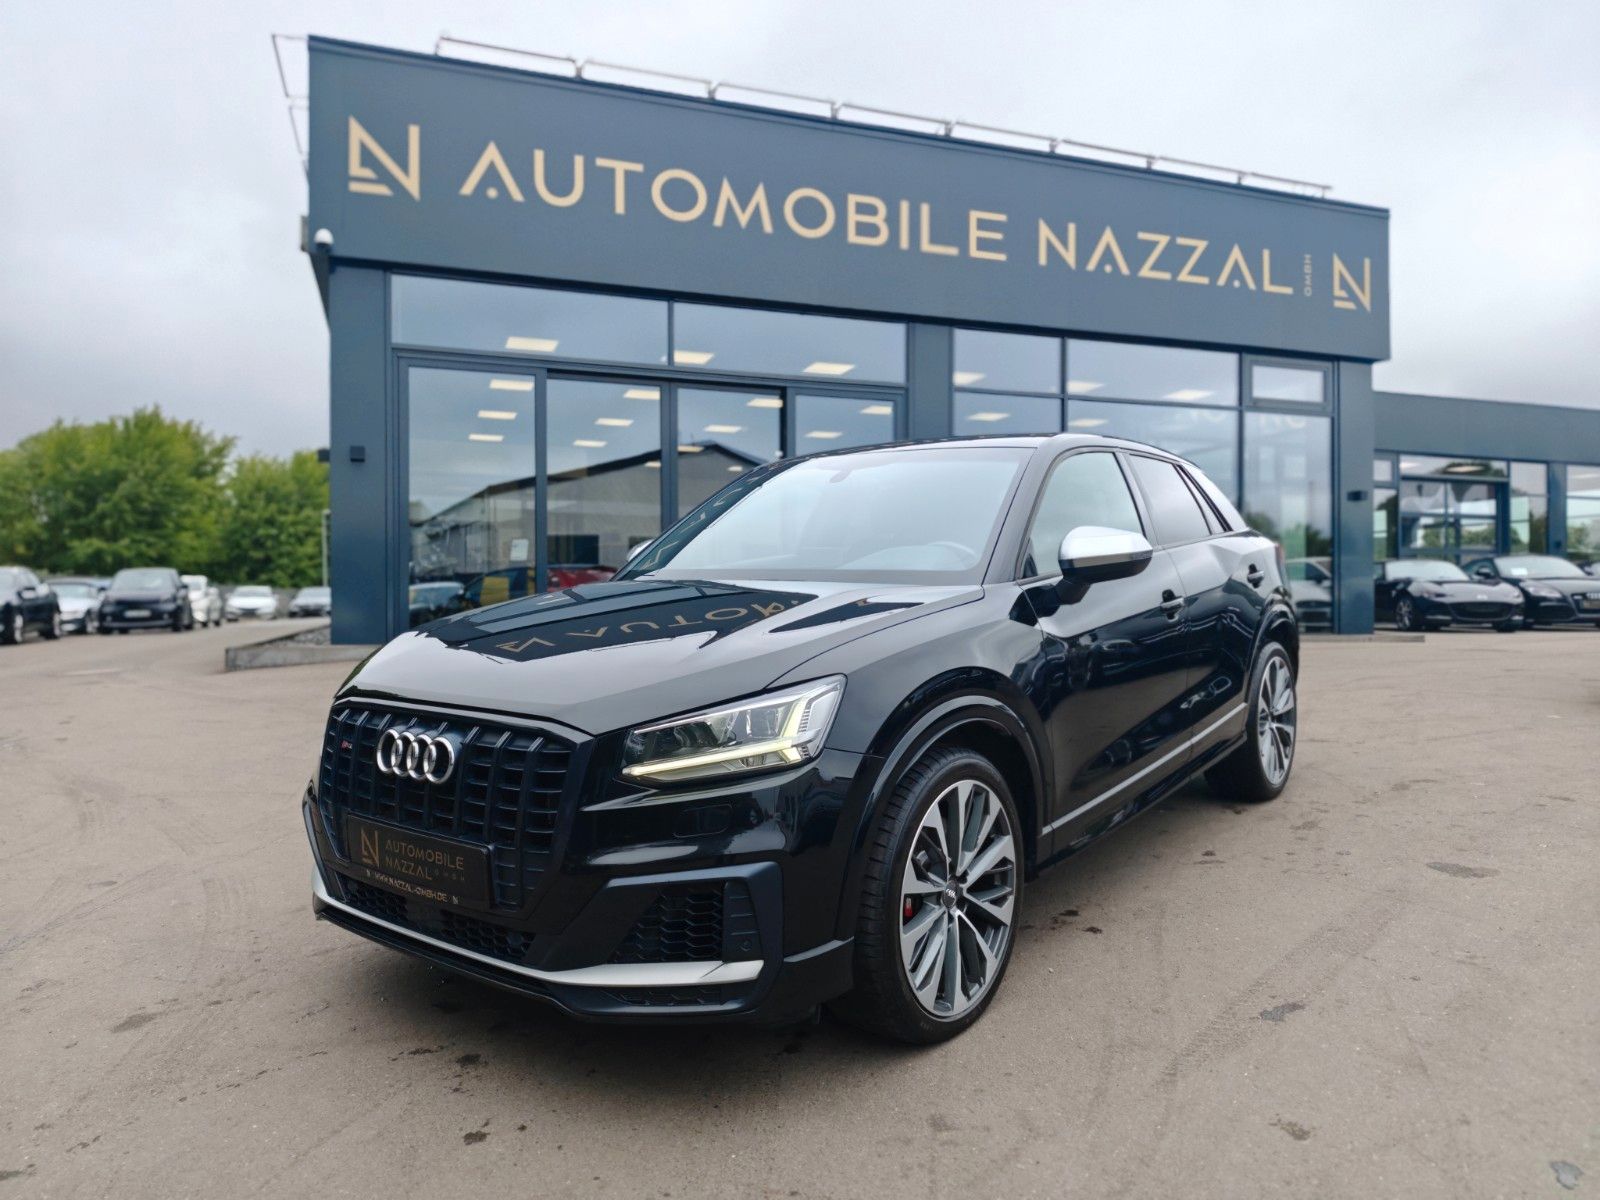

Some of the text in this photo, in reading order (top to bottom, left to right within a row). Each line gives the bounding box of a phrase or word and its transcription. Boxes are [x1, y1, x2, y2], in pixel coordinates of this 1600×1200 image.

[458, 139, 1009, 263] AUTOMOBILE
[1037, 217, 1294, 296] NAZZAL
[385, 840, 464, 870] AUTOMOBILE
[385, 856, 433, 881] NAZZAL
